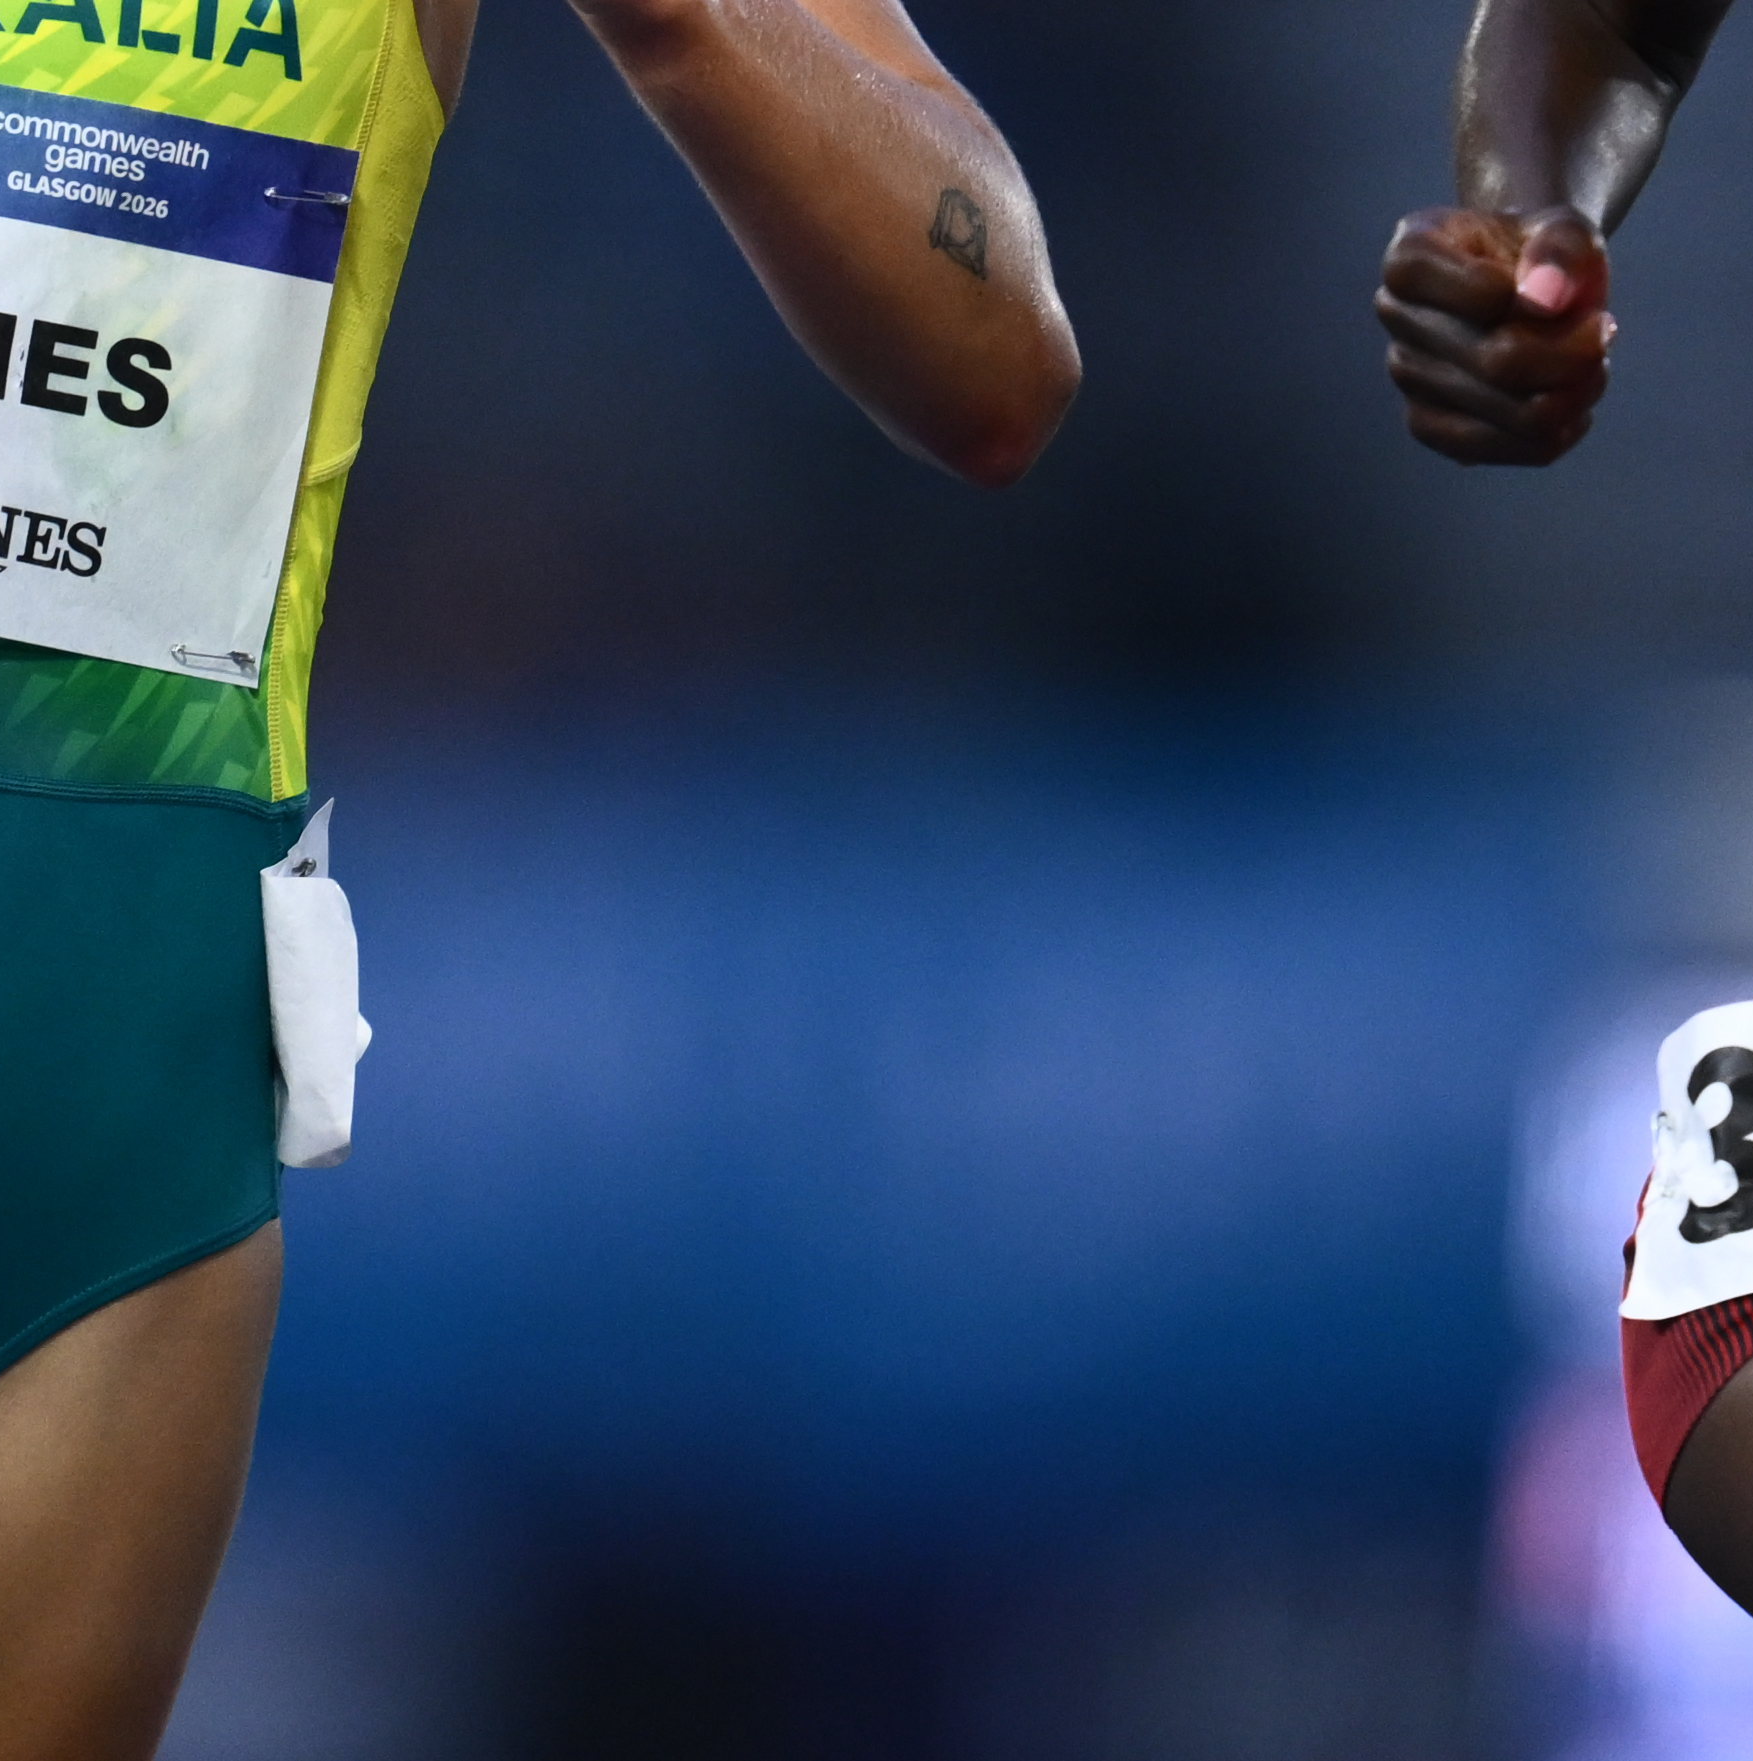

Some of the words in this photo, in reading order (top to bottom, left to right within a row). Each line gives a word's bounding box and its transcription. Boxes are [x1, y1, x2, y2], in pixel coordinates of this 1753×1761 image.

[44, 144, 146, 182] games
[7, 170, 117, 208] GLASGOW
[118, 192, 169, 219] 2026
